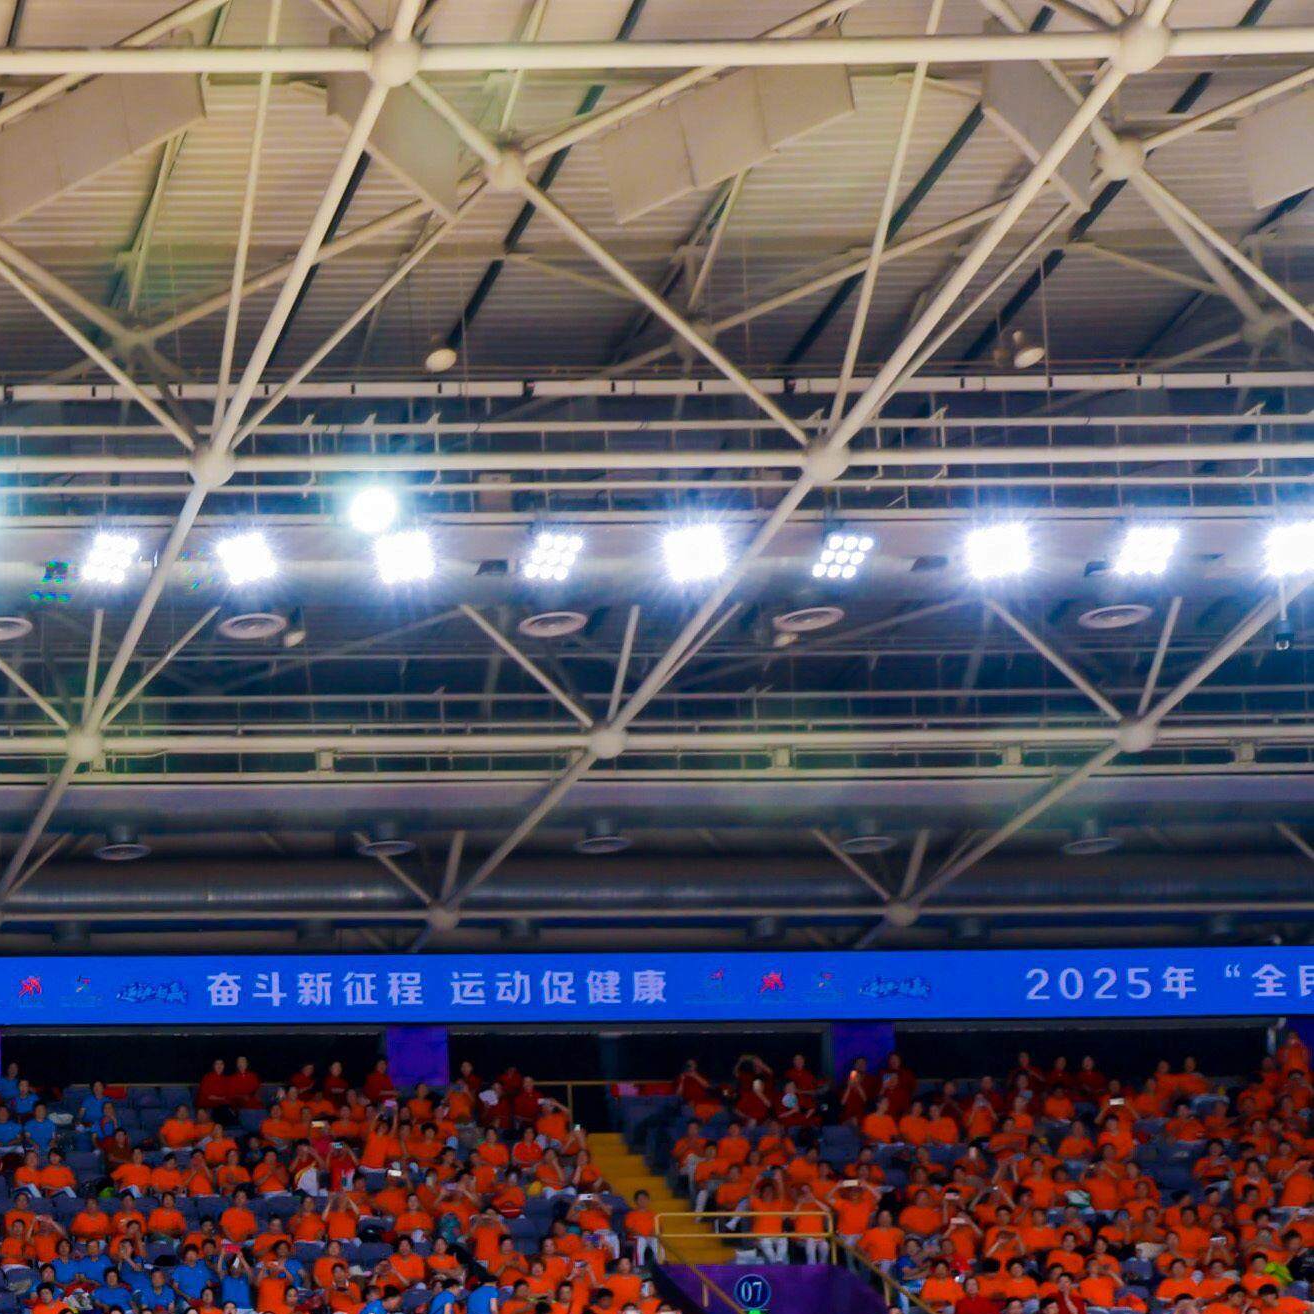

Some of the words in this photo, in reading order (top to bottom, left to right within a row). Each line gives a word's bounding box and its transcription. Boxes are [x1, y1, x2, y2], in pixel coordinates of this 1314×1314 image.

[207, 970, 424, 1007] 奋斗新征程
[450, 969, 667, 1005] 运动促健康
[741, 1281, 763, 1303] 07
